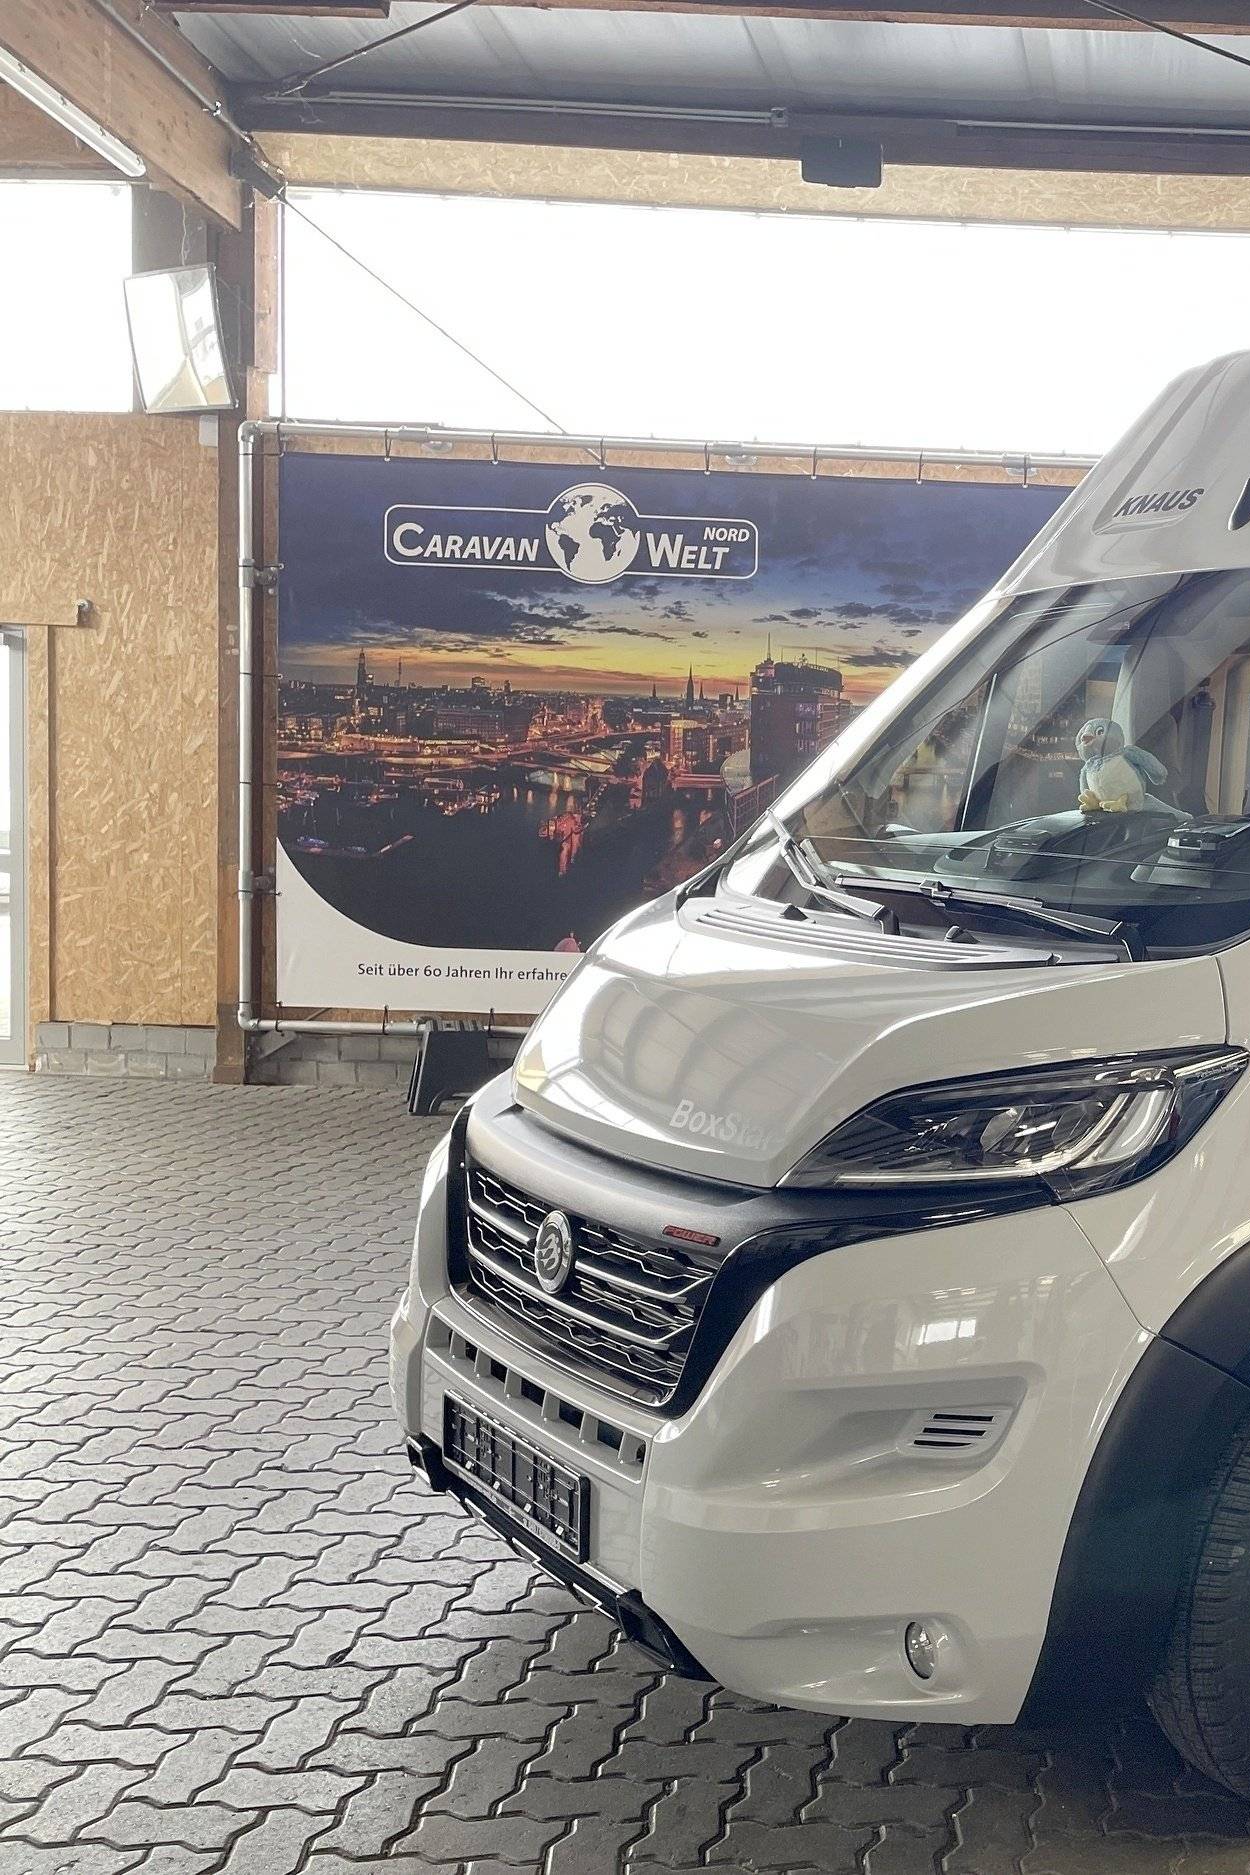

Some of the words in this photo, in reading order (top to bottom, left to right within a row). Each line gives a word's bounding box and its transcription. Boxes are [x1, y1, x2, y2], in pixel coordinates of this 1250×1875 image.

[1112, 488, 1205, 518] KNAUS
[392, 522, 540, 562] CARAVAN
[646, 532, 730, 570] WELT
[703, 525, 751, 544] NORD
[357, 963, 384, 976] Seit
[387, 963, 420, 978] über
[423, 965, 442, 978] 60
[444, 965, 491, 980] Jahren
[495, 966, 515, 980] Ihr
[517, 968, 568, 982] erfahre
[669, 1098, 771, 1152] BoxStar
[664, 1225, 717, 1246] POWER
